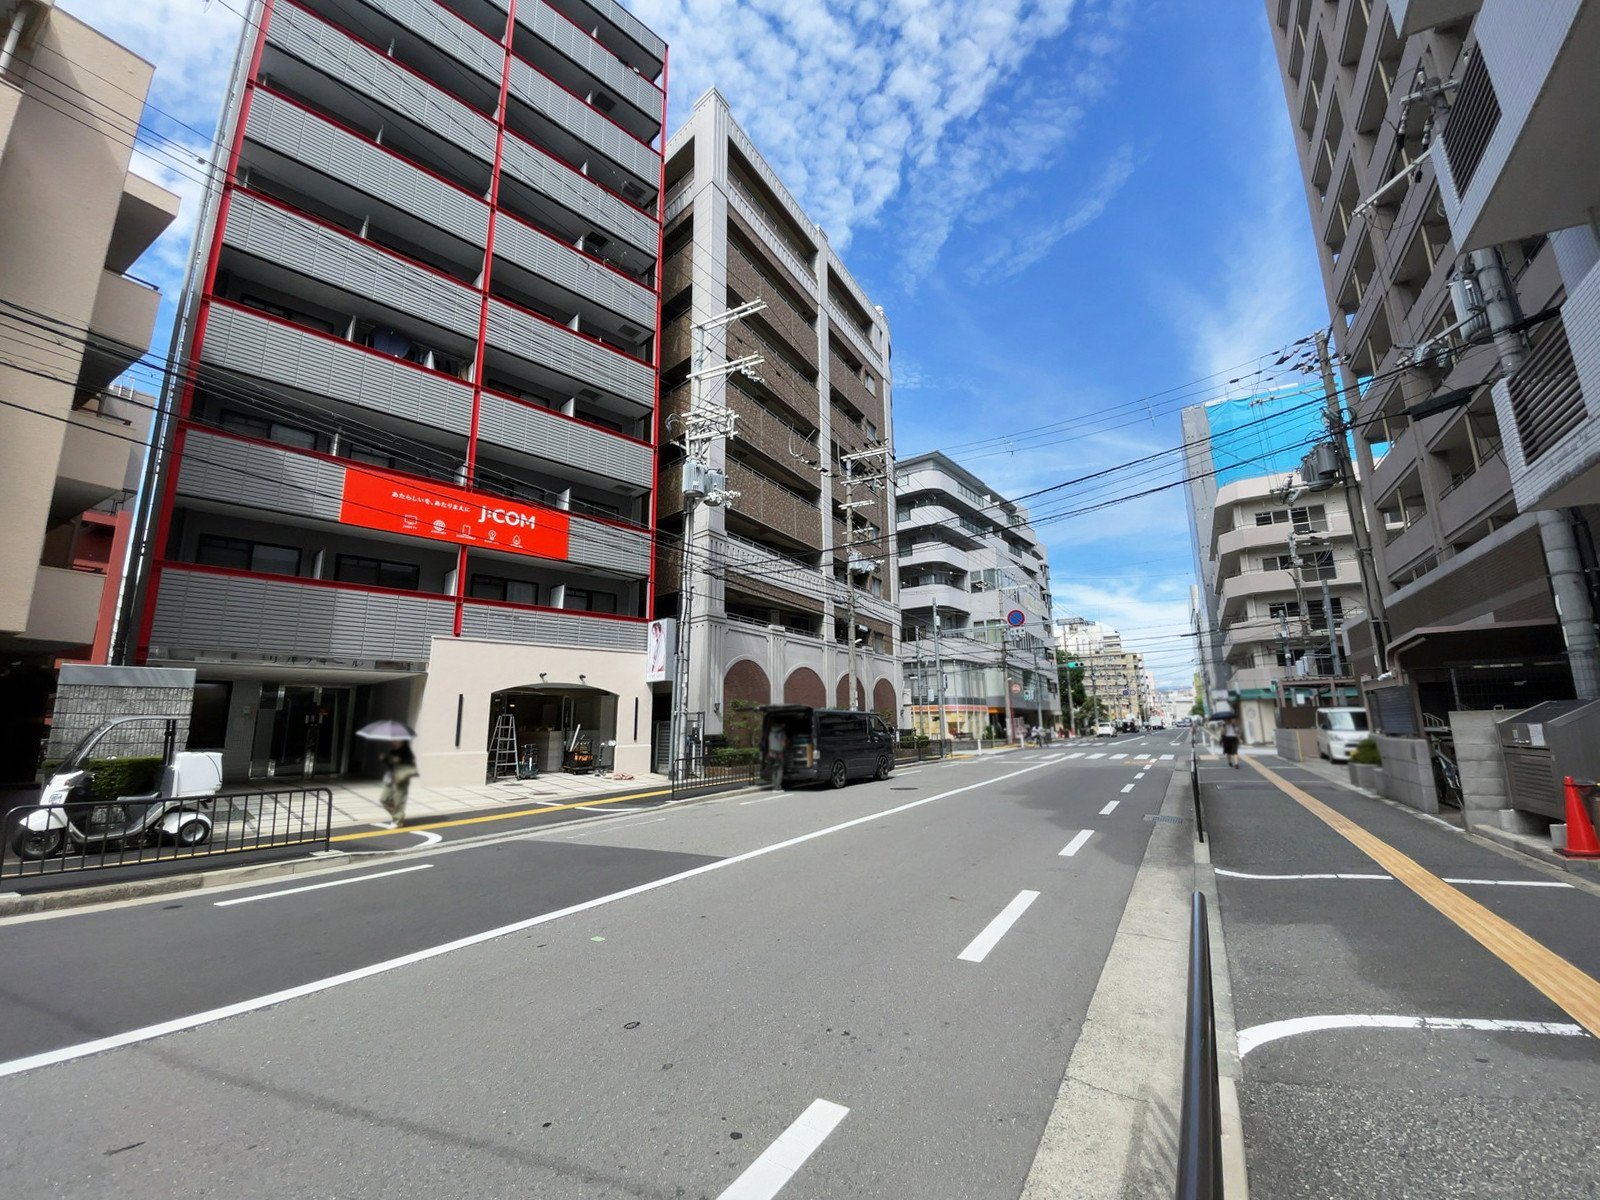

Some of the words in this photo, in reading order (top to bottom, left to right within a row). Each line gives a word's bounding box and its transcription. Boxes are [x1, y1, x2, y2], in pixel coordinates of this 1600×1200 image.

[392, 491, 471, 512] あたらしいを、あたりまえに
